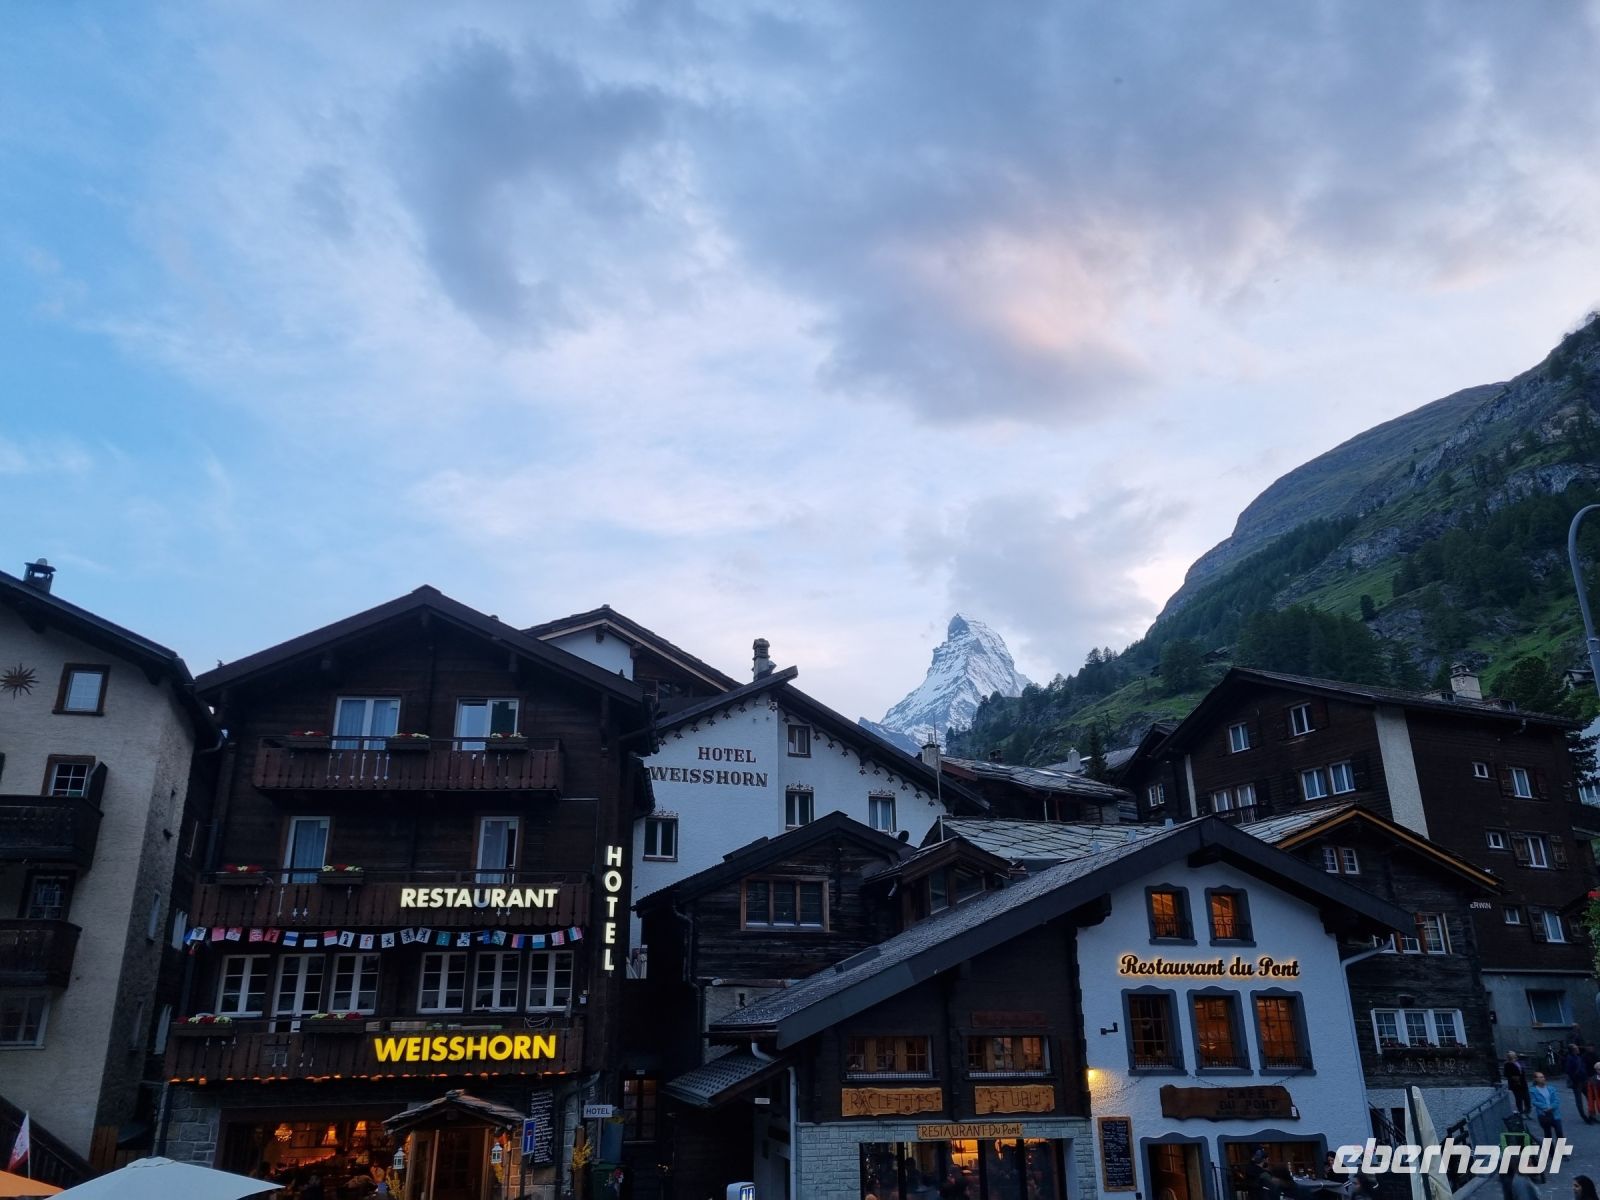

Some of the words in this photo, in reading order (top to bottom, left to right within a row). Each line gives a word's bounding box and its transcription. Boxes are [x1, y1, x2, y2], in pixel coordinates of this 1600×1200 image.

[697, 746, 757, 763] HOTEL
[649, 766, 768, 787] WEISSHORN
[400, 887, 559, 909] RESTAURANT
[604, 845, 622, 971] HOTEL
[1119, 954, 1226, 976] Restaurant
[1229, 957, 1255, 976] du
[1258, 956, 1300, 977] Pont
[374, 1034, 556, 1063] WEISSHORN
[586, 1107, 610, 1115] HOTEL
